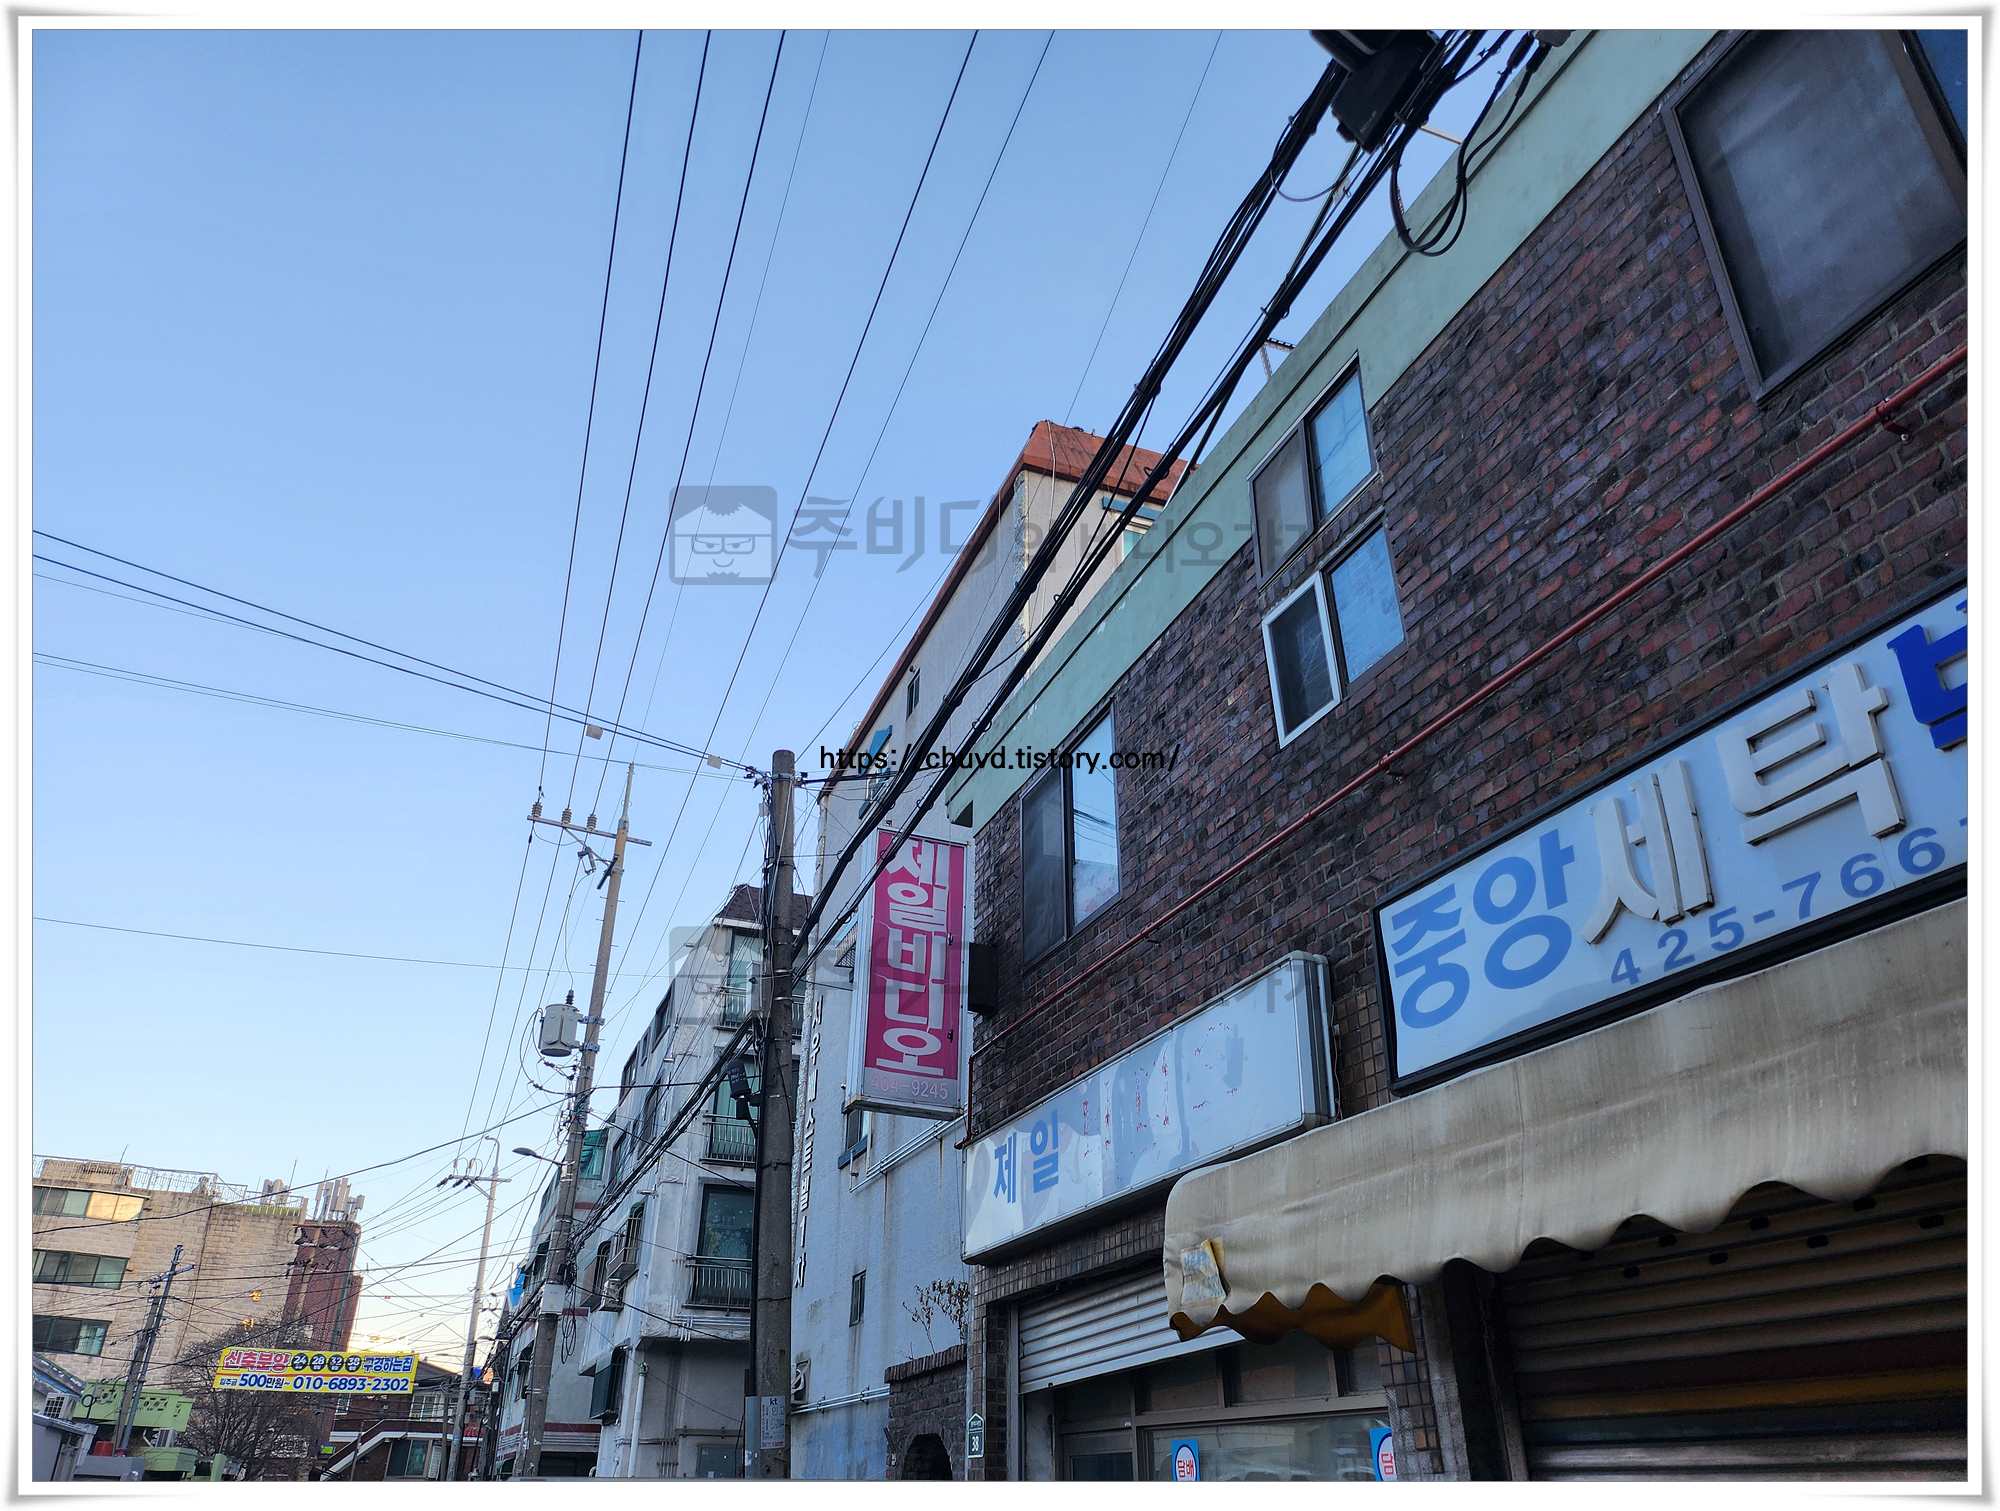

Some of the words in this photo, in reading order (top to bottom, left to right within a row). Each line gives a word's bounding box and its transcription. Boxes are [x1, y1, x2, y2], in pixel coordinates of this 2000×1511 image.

[1391, 829, 1576, 1030] 중앙
[1610, 818, 1967, 987] 425-766
[876, 833, 951, 1078] 제일비디오
[223, 1350, 290, 1372] 신축분양
[293, 1355, 306, 1364] 24
[312, 1356, 325, 1365] 28
[363, 1356, 414, 1373] 구경하는집
[293, 1376, 409, 1391] 010-6893-2302
[769, 1398, 778, 1406] kt
